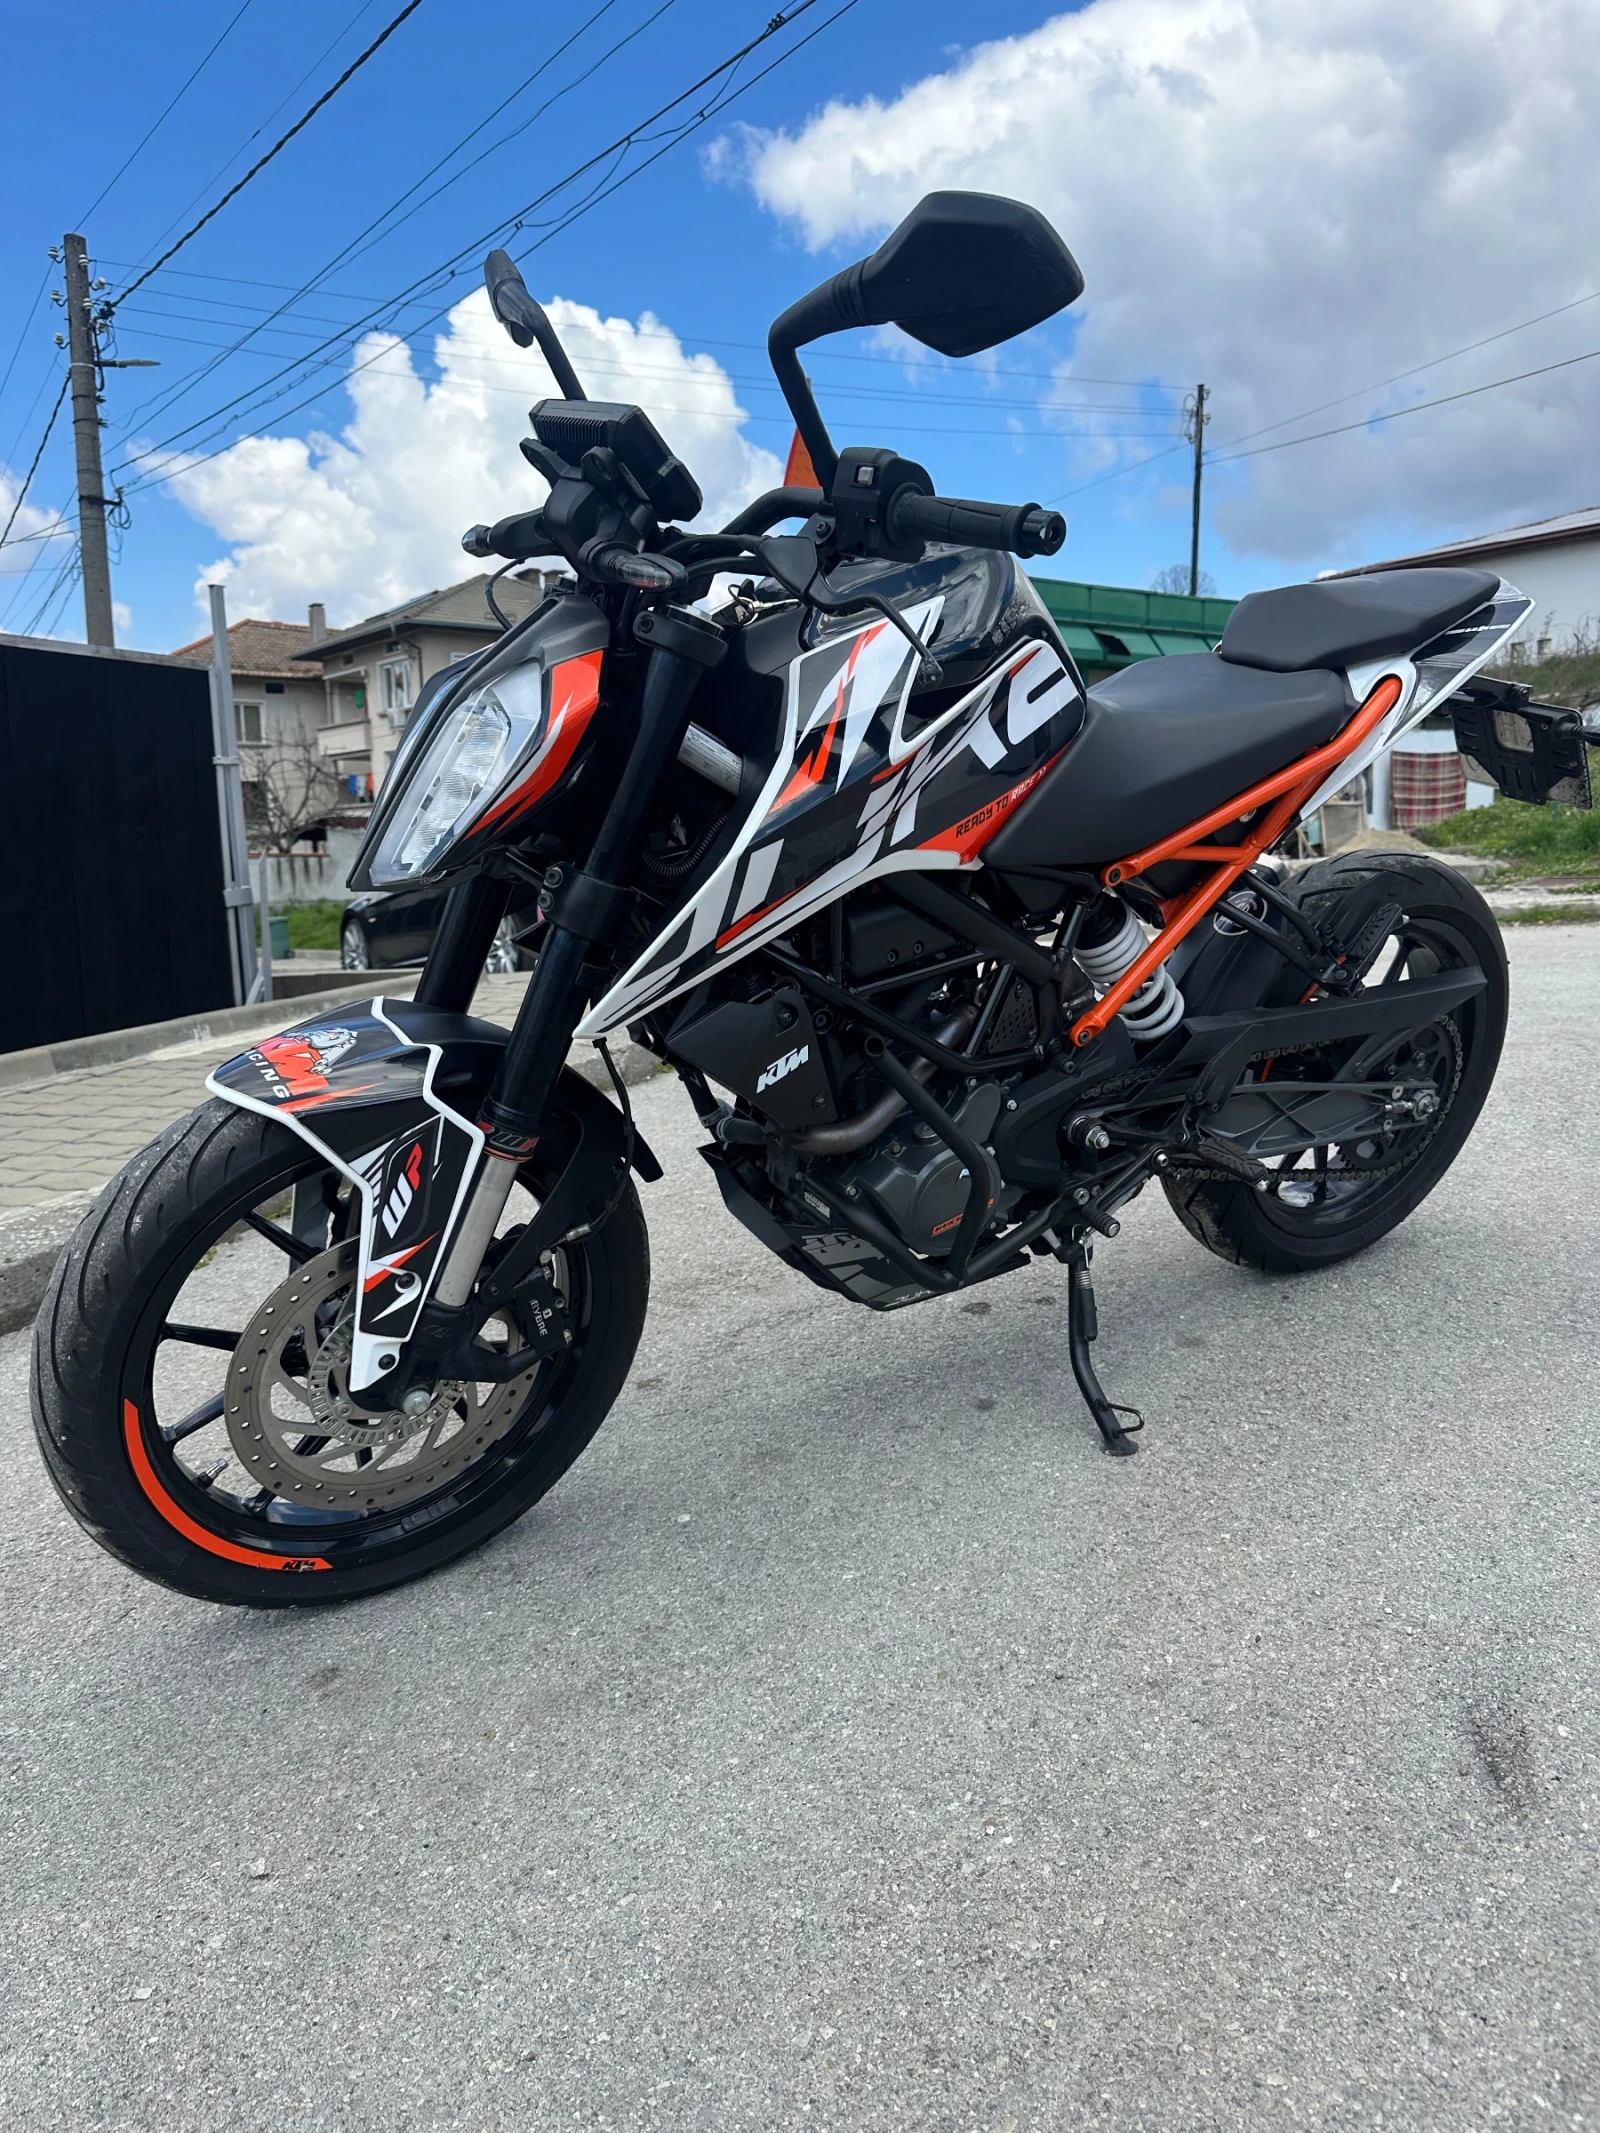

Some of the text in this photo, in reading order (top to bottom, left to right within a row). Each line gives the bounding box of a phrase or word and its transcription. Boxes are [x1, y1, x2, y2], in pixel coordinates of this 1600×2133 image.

[955, 774, 1037, 839] READY TO RACE
[756, 1044, 809, 1094] KTM
[529, 1298, 549, 1338] BYBRE
